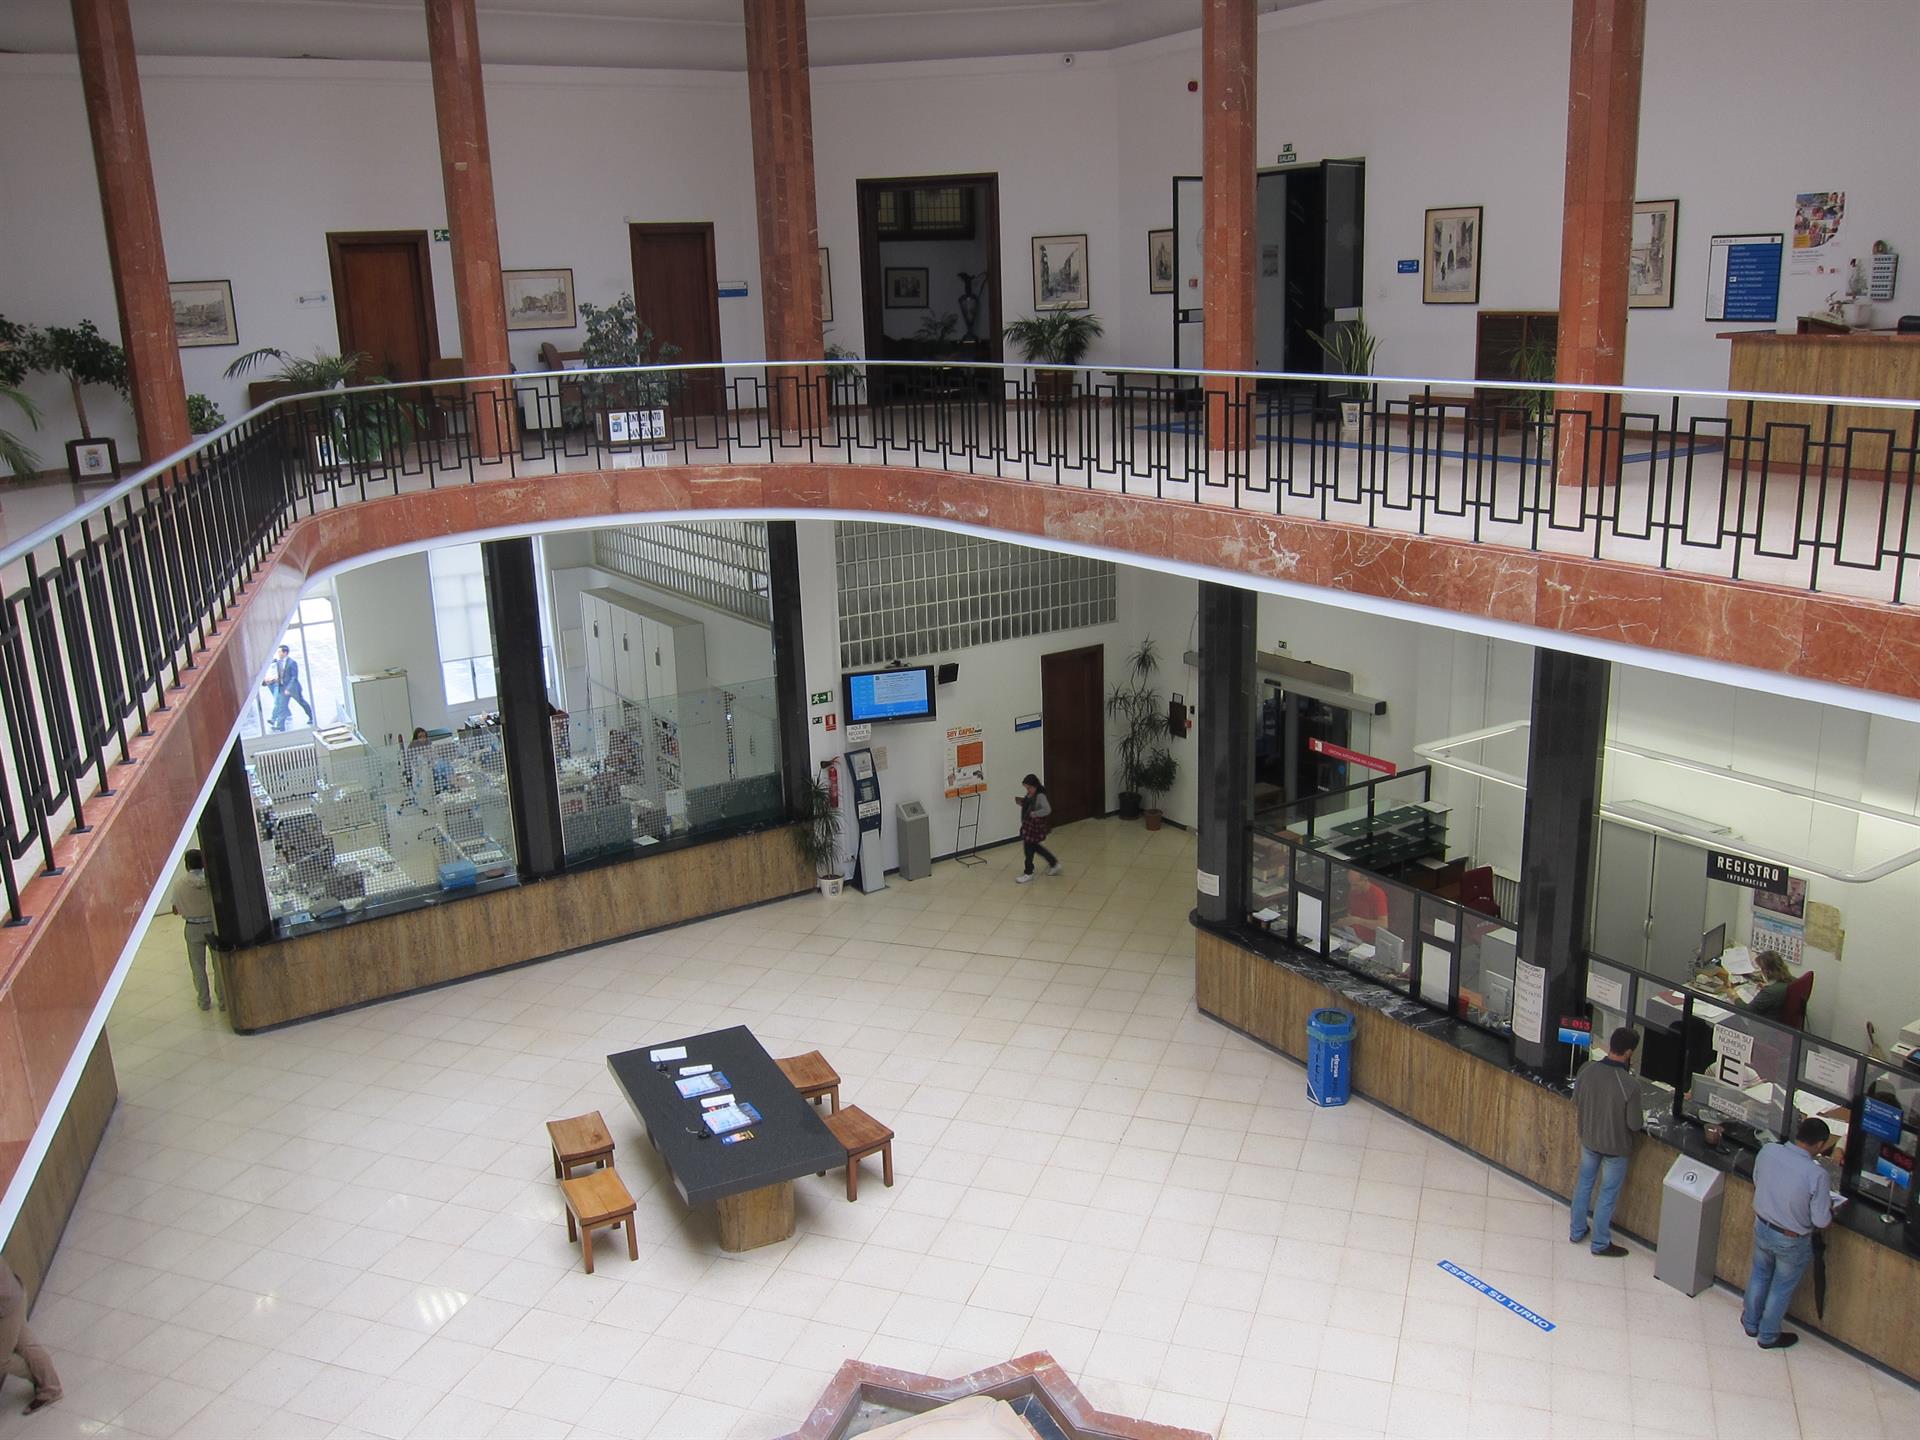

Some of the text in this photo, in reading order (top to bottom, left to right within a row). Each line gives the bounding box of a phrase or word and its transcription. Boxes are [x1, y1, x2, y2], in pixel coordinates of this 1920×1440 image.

[1717, 855, 1779, 881] REGISTRO
[1571, 1032, 1578, 1042] 7
[1742, 1035, 1752, 1045] SU
[1722, 1045, 1741, 1057] TECLA
[1719, 1054, 1741, 1087] E
[1890, 1167, 1898, 1179] 5
[1441, 1262, 1549, 1328] ESPERE SU TURNO
